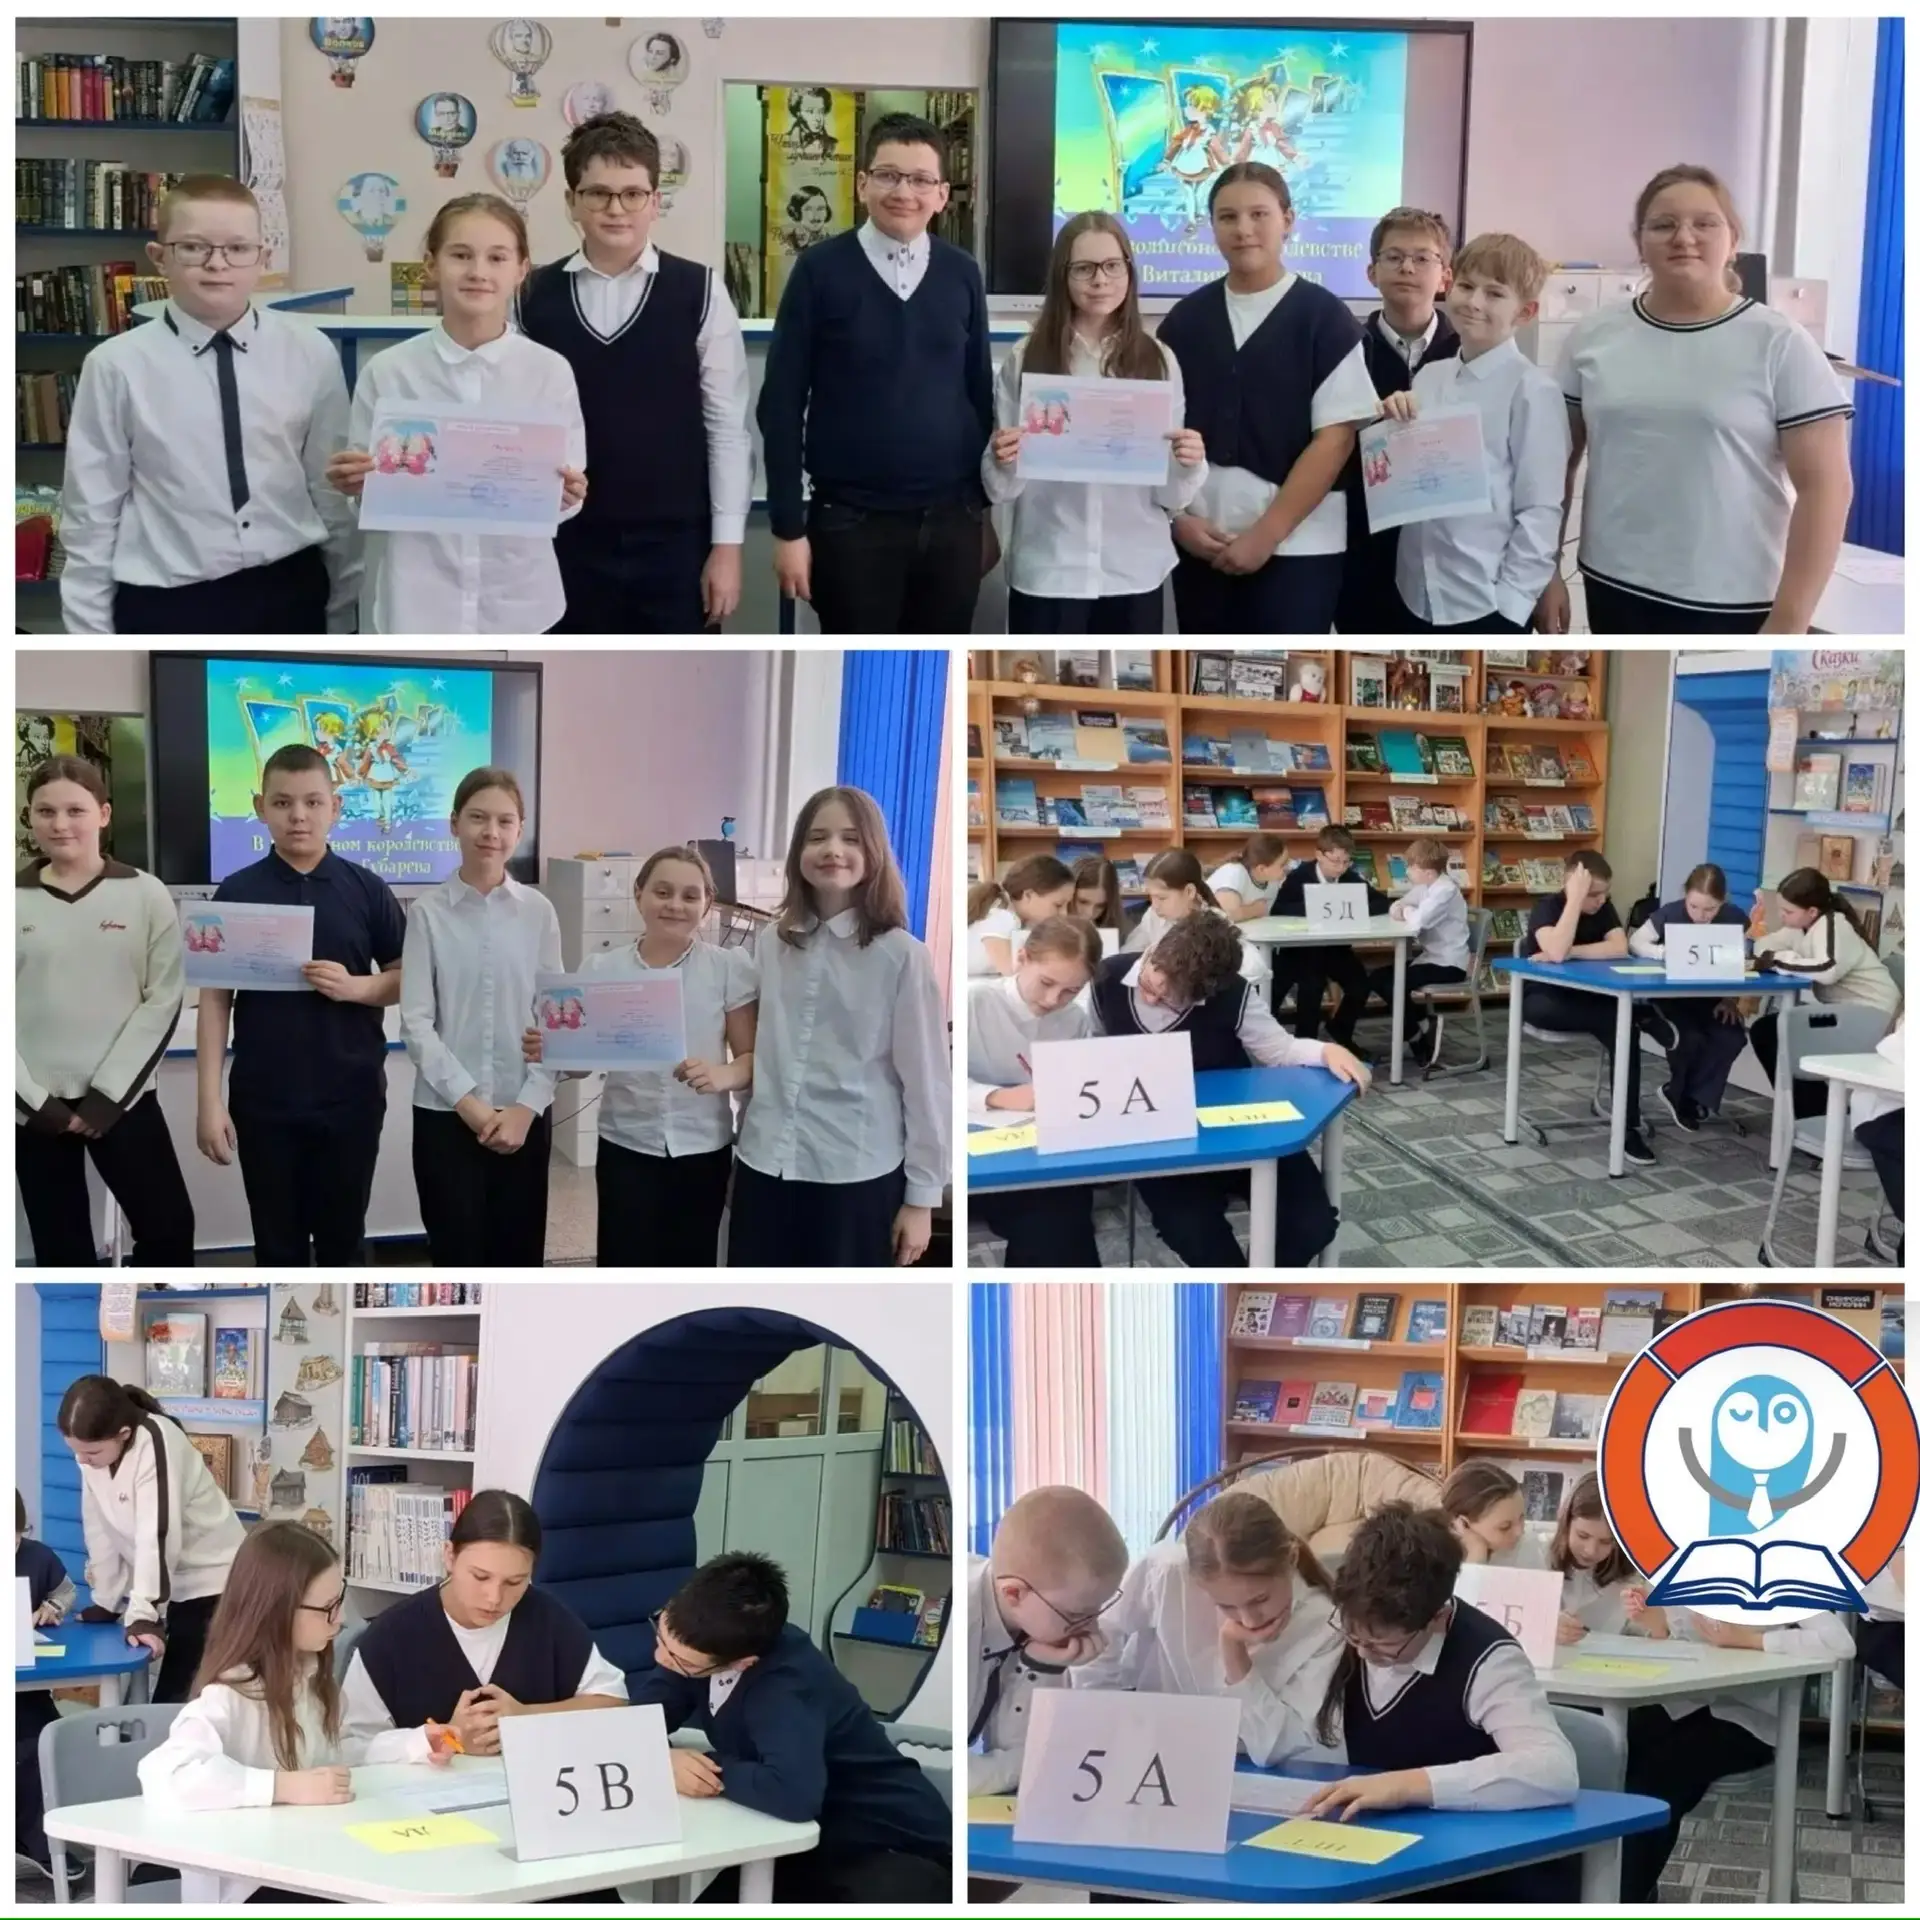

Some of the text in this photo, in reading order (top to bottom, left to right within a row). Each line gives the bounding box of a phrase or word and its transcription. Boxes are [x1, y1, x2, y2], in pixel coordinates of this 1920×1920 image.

[1130, 238, 1218, 256] волшебно
[1142, 265, 1229, 284] Витали
[253, 835, 264, 852] В
[1322, 901, 1355, 920] 5 Д
[1687, 944, 1723, 966] 5 Г
[1078, 1077, 1159, 1119] 5 А
[1503, 1603, 1523, 1637] Б
[1072, 1749, 1178, 1807] 5 А
[555, 1762, 634, 1817] 5 В
